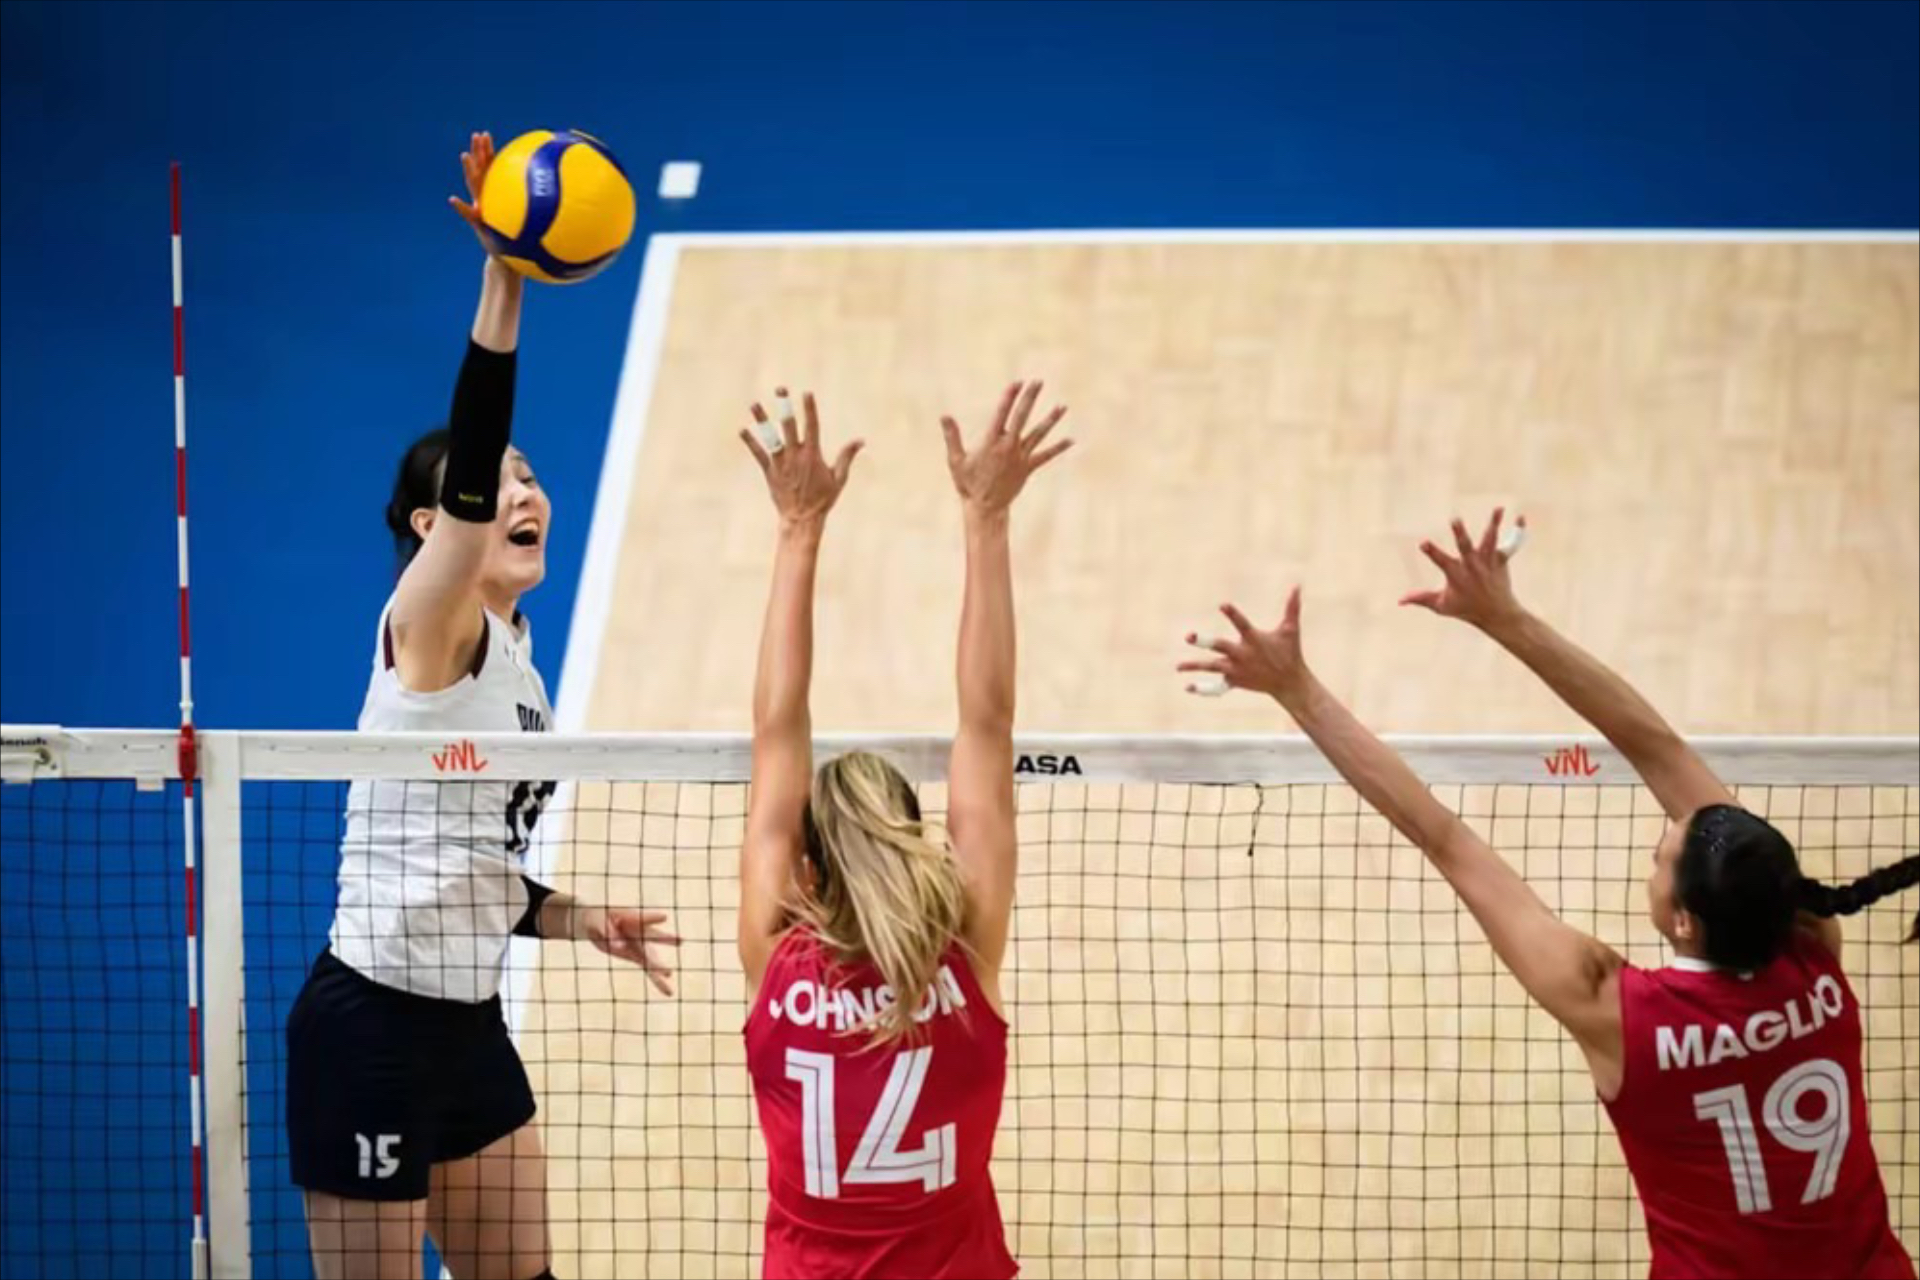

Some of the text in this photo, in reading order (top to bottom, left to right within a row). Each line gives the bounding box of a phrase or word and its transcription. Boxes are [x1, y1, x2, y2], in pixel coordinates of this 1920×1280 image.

[1655, 974, 1843, 1071] MAGLIO
[355, 1132, 402, 1178] 15
[785, 1046, 957, 1199] 14
[1692, 1058, 1851, 1215] 19
